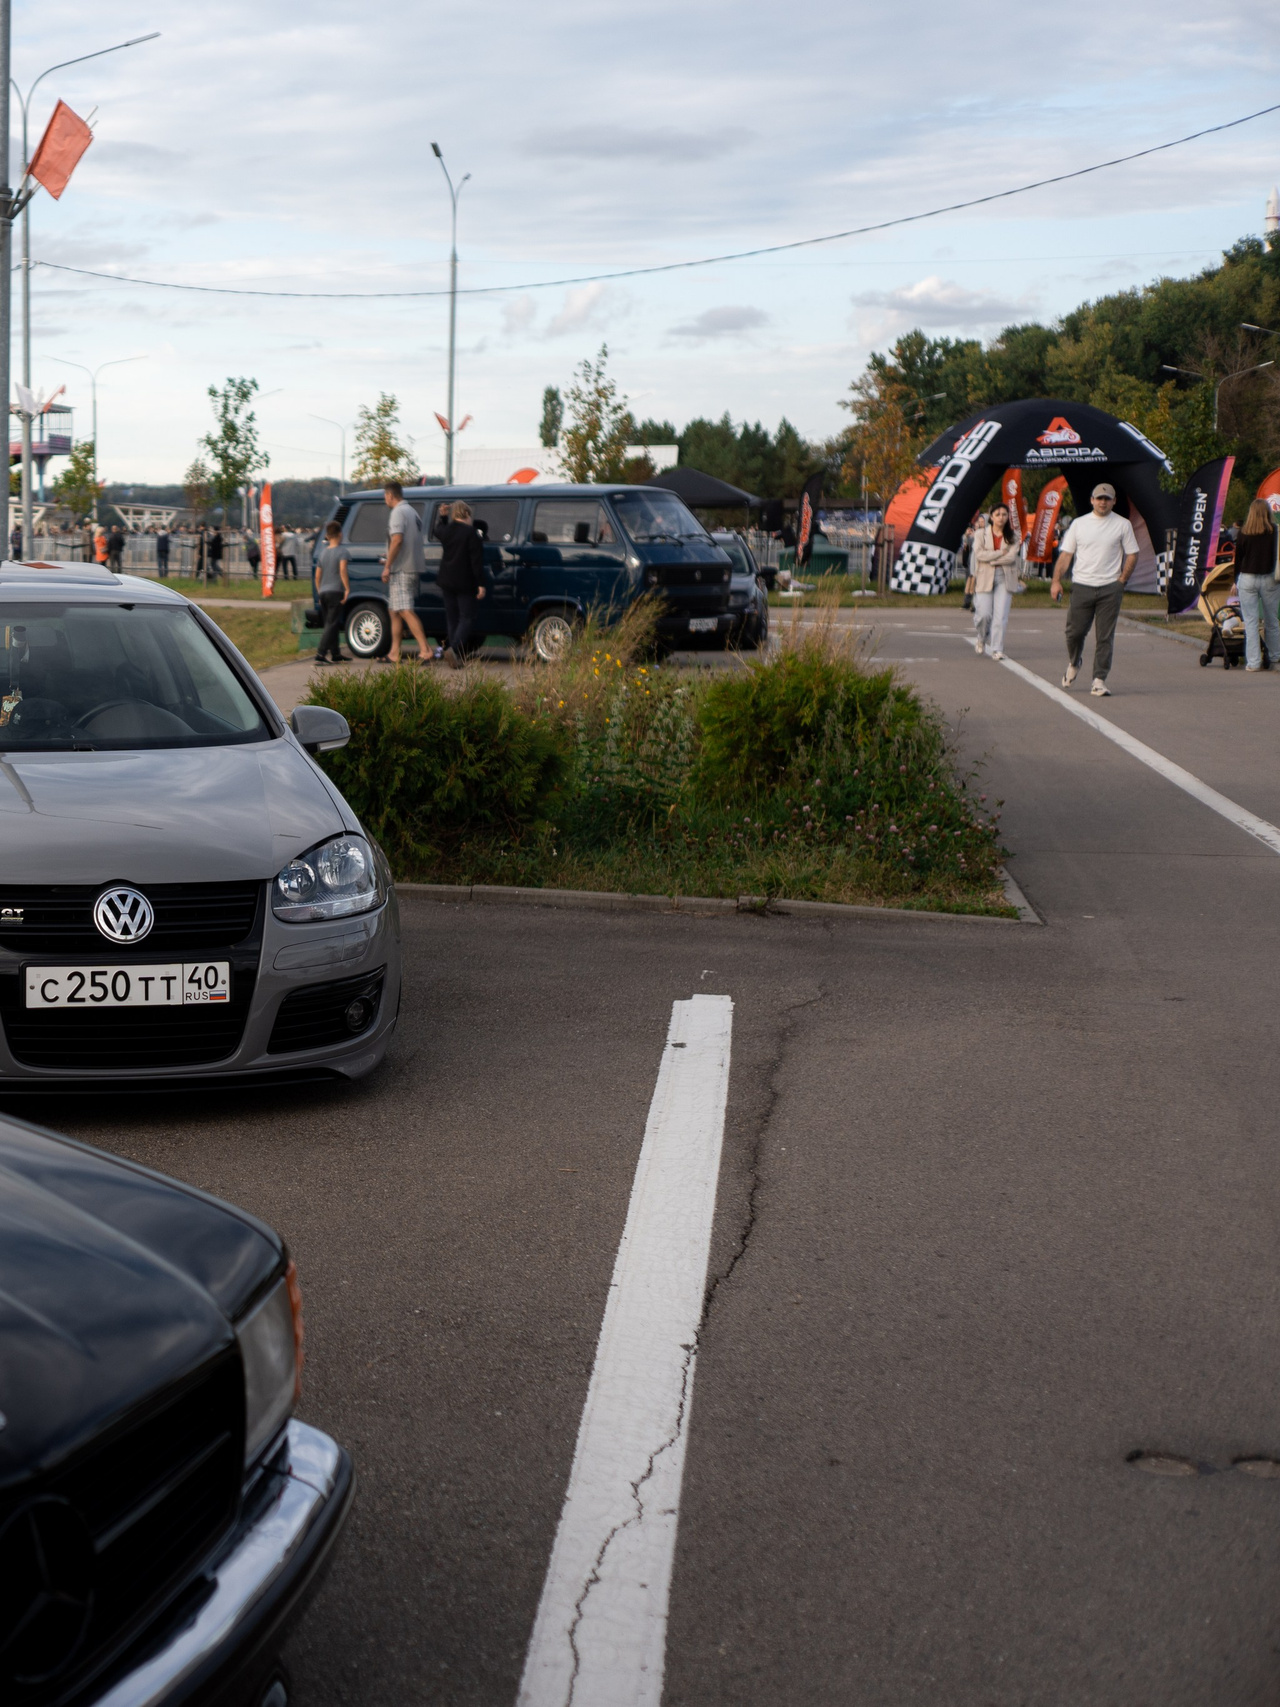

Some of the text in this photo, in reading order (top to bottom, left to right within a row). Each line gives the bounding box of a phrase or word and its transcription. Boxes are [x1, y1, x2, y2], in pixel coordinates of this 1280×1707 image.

[1026, 447, 1105, 457] АВРОРА
[916, 421, 1002, 534] AODES
[1037, 509, 1054, 557] TAKAYAMA
[1185, 537, 1201, 587] SMART
[188, 965, 218, 990] 40
[185, 991, 209, 1001] RUS
